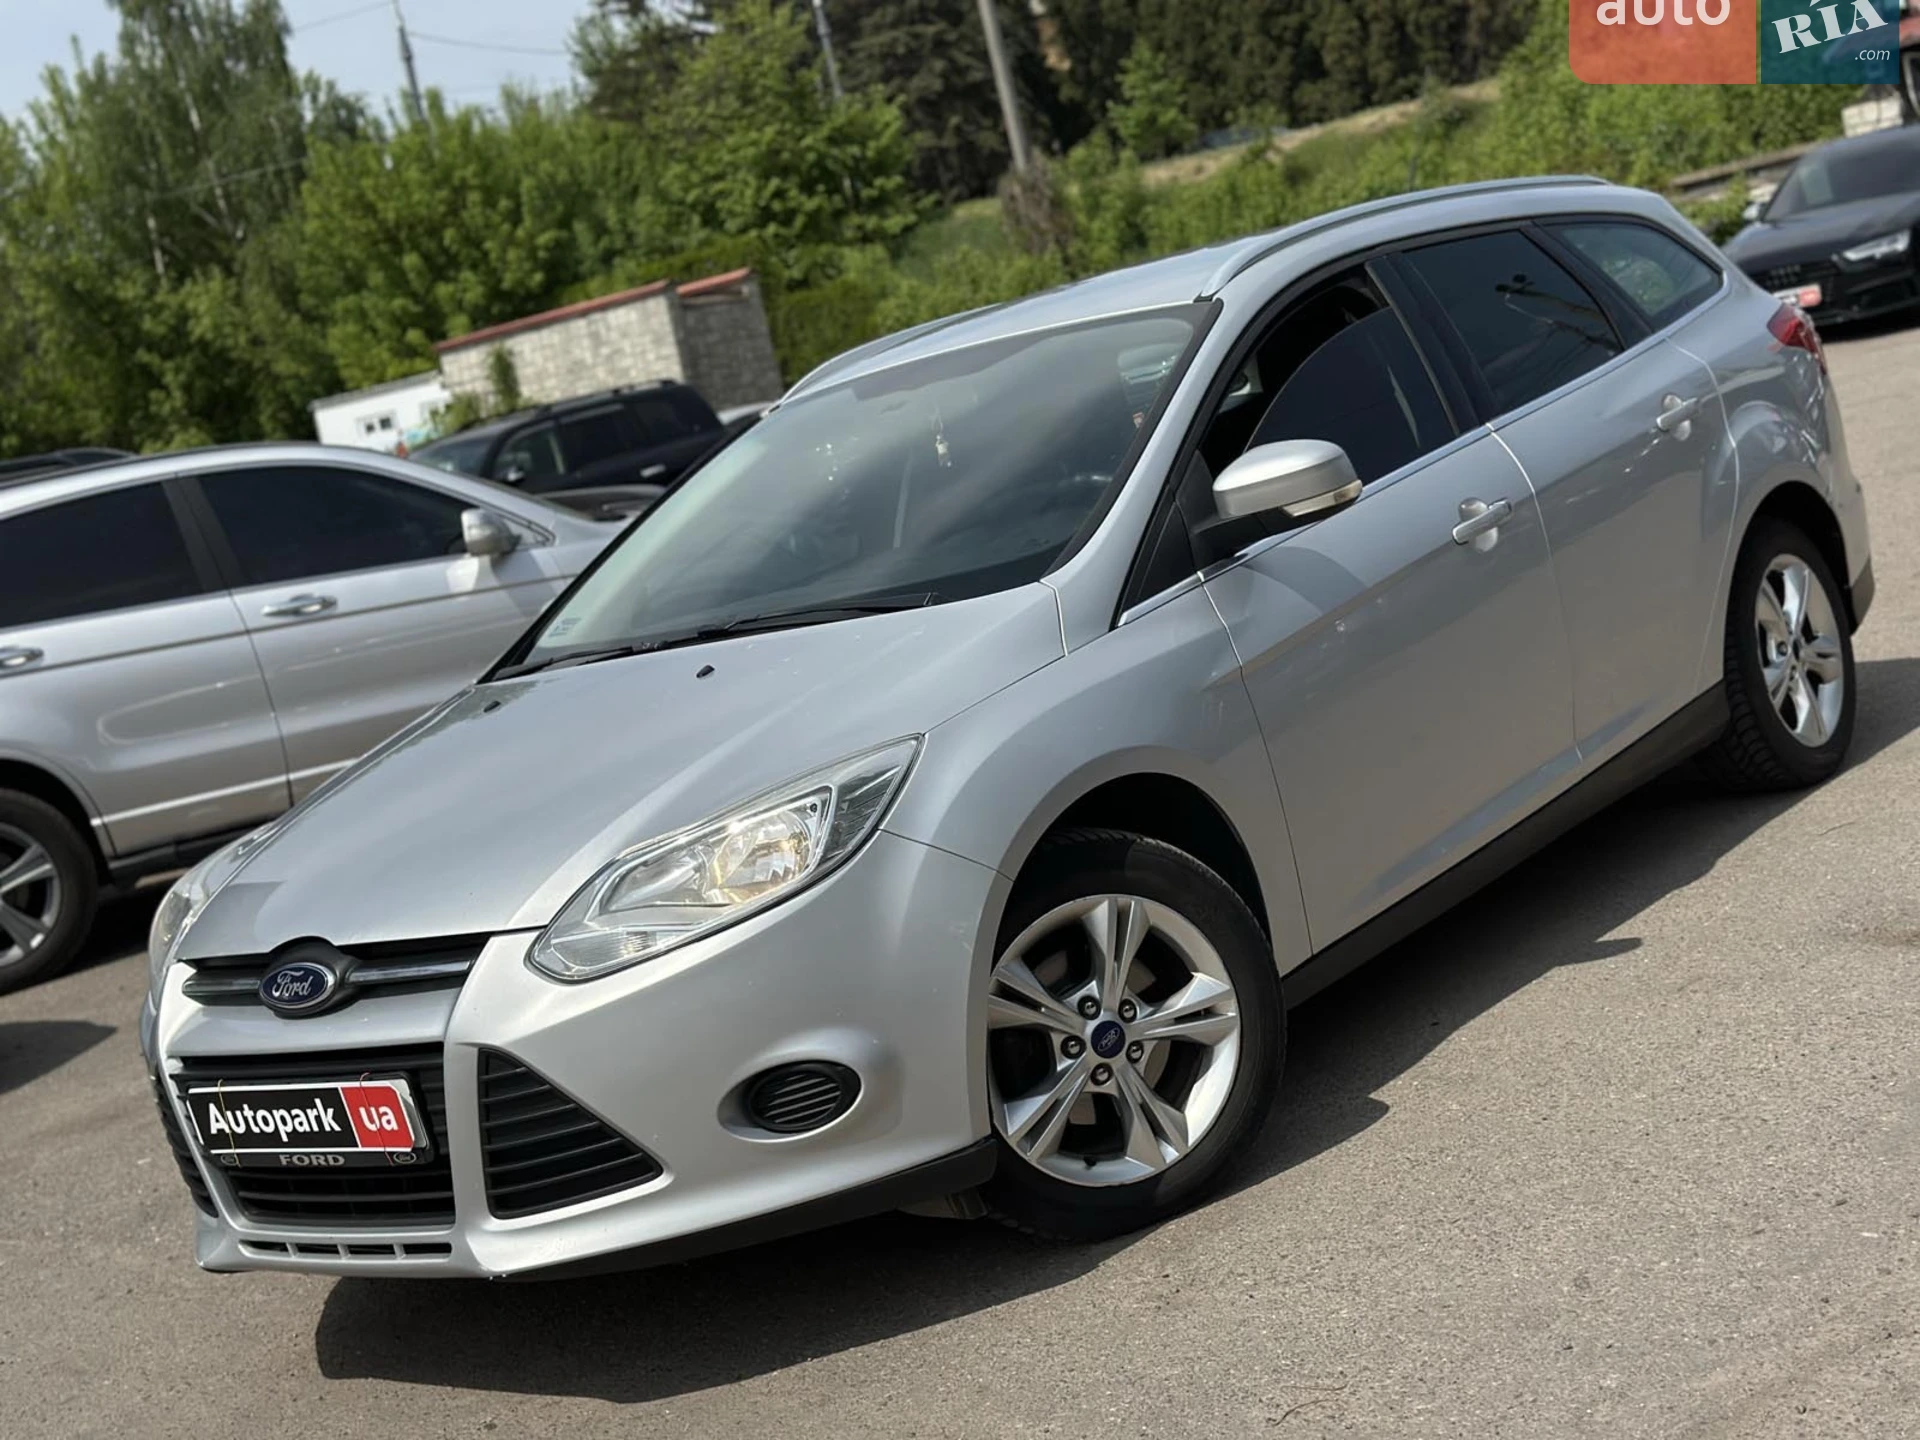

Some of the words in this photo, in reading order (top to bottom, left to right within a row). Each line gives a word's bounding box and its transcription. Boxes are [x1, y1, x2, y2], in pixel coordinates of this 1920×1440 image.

[271, 970, 314, 998] Ford
[208, 1098, 342, 1142] Autopark
[358, 1104, 400, 1132] ua
[279, 1153, 346, 1167] FORD
